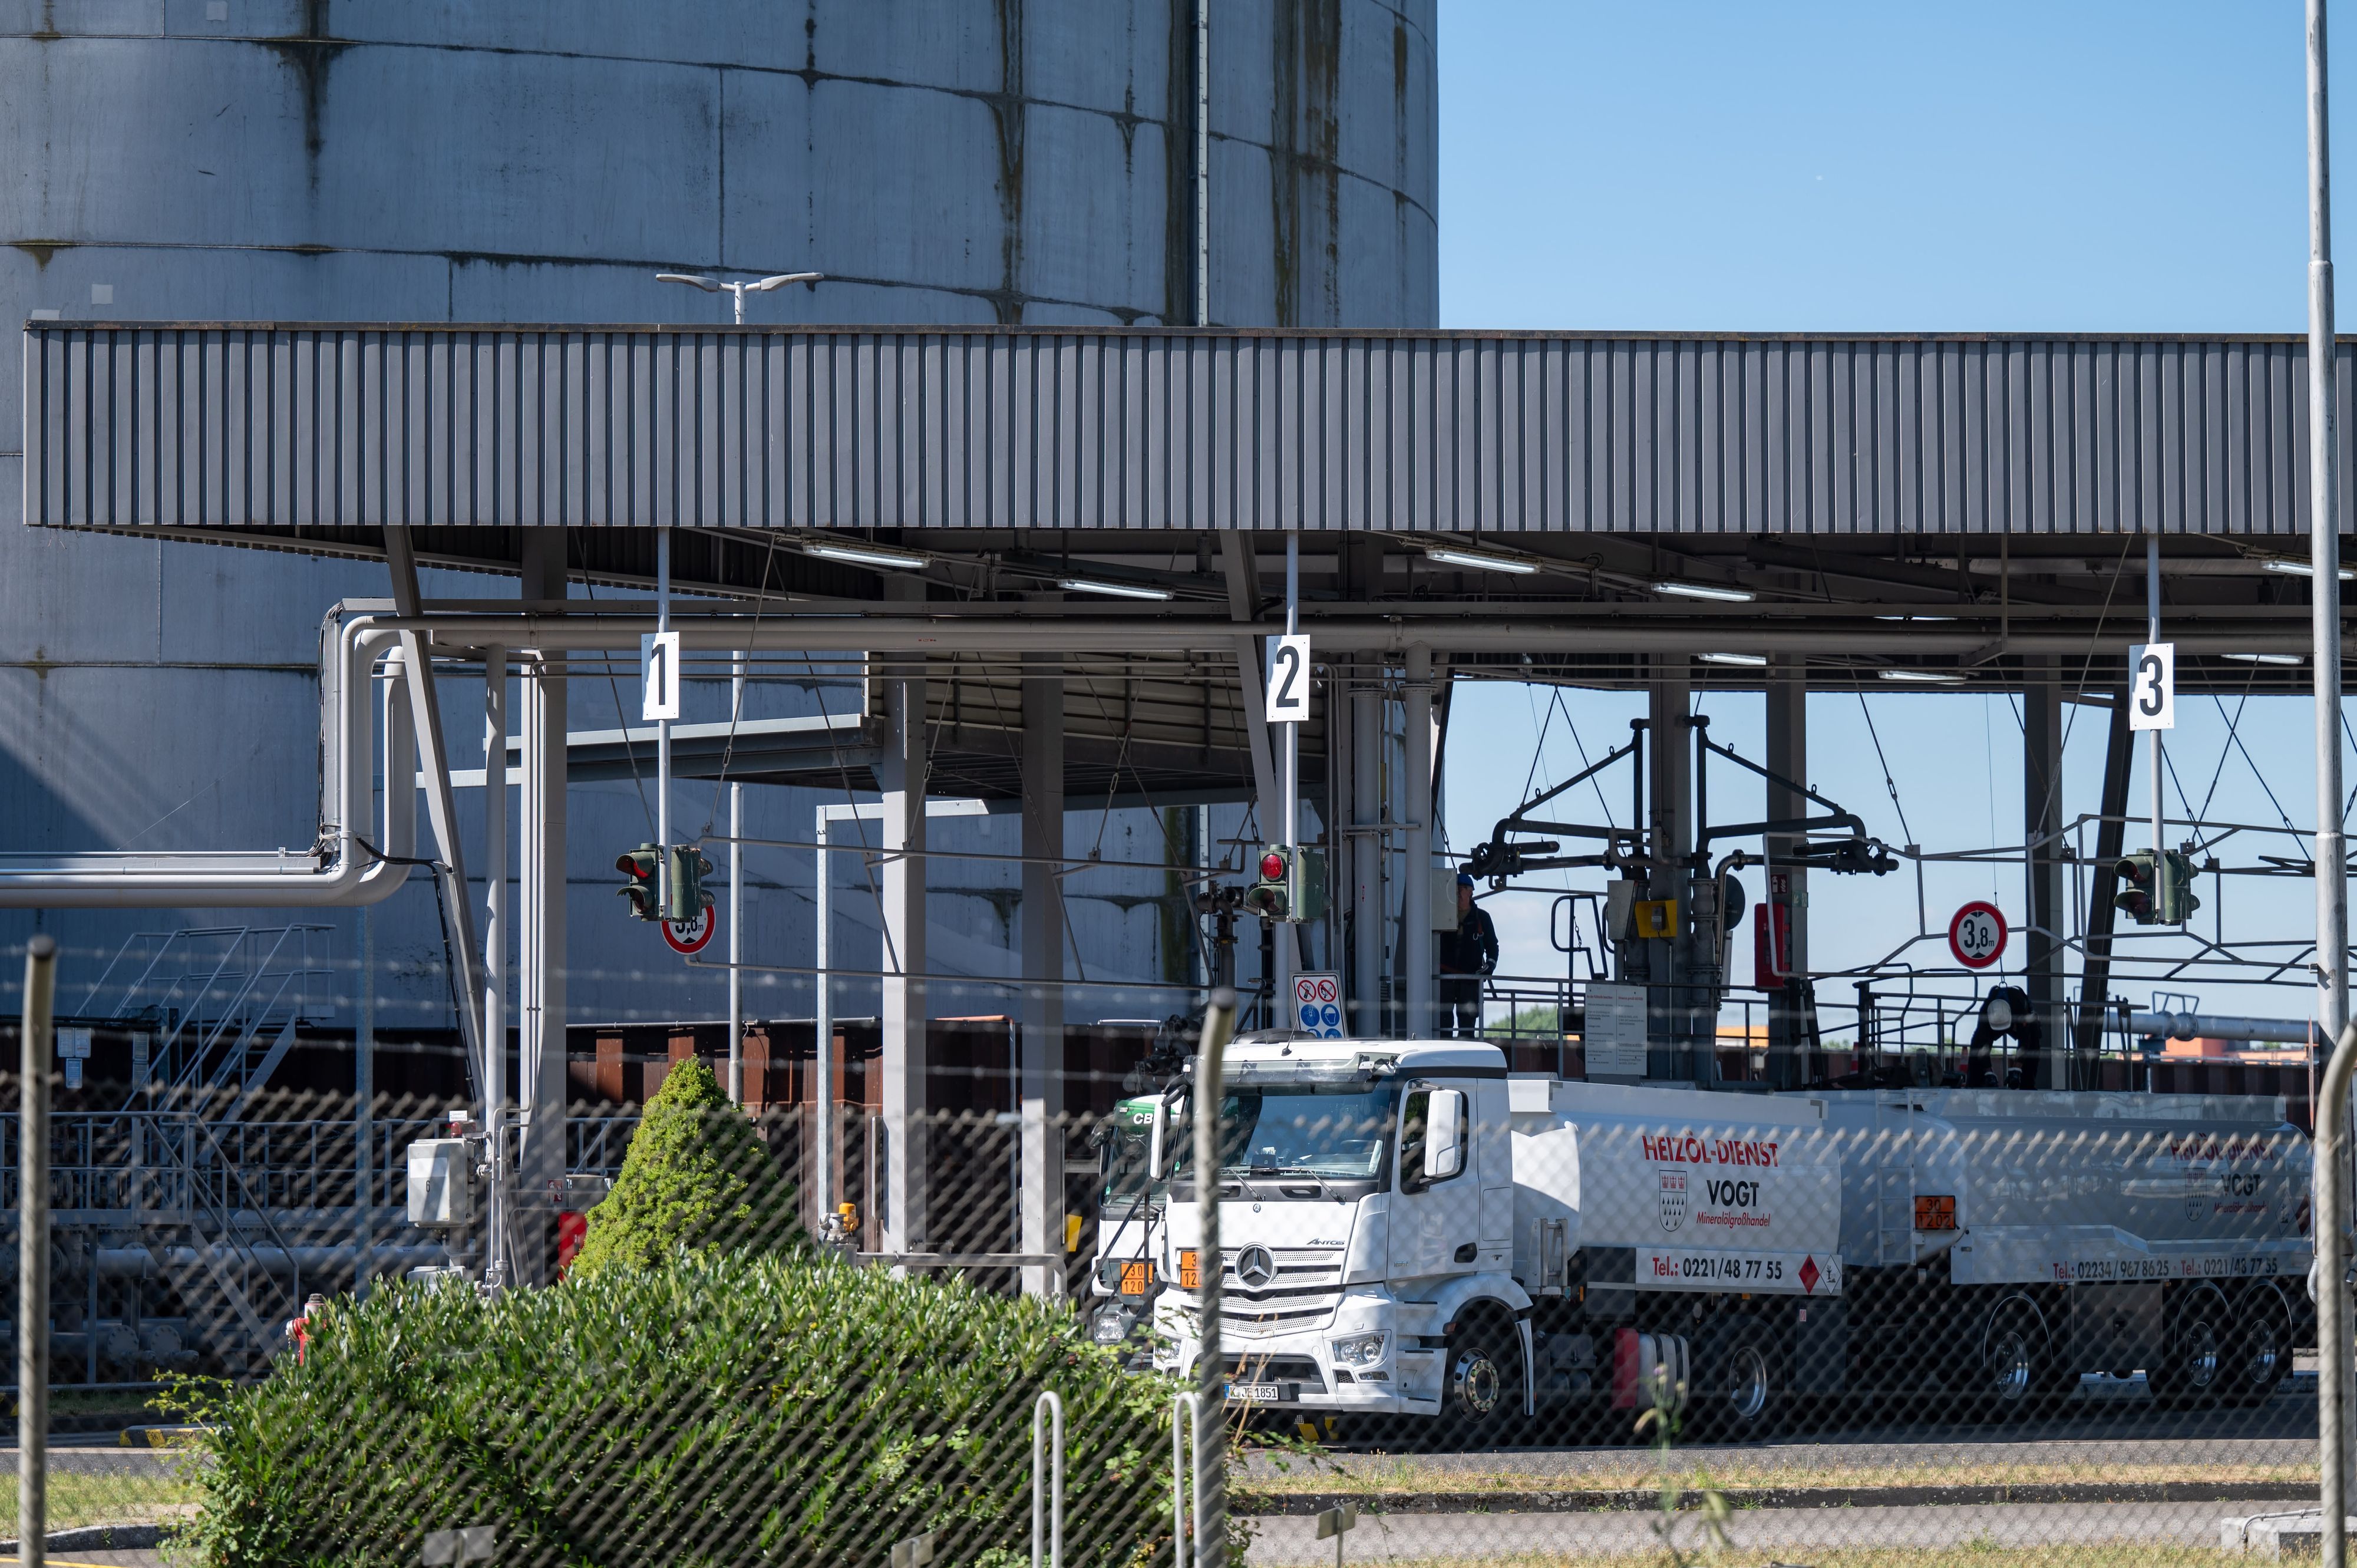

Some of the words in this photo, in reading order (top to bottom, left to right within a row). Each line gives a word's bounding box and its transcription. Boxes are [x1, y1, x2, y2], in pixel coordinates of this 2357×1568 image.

[652, 643, 665, 705] 1
[1276, 645, 1299, 708] 2
[2139, 655, 2163, 717] 3
[1642, 1130, 1778, 1167] HEIZÖL-DIENST
[425, 1180, 431, 1193] 6
[1706, 1180, 1760, 1207] VOGT
[2221, 1173, 2261, 1197] VOGT
[1927, 1199, 1941, 1211] 30
[1696, 1212, 1771, 1229] Mineralölgroßhandel
[1918, 1215, 1950, 1227] 1202
[1652, 1256, 1678, 1276] Tel.:
[1683, 1257, 1741, 1279] 0221/48
[1745, 1260, 1762, 1279] 77
[1766, 1261, 1782, 1280] 55
[2053, 1260, 2075, 1279] Tel.:
[2181, 1258, 2201, 1276] Tel.:
[1255, 1388, 1277, 1398] 1851
